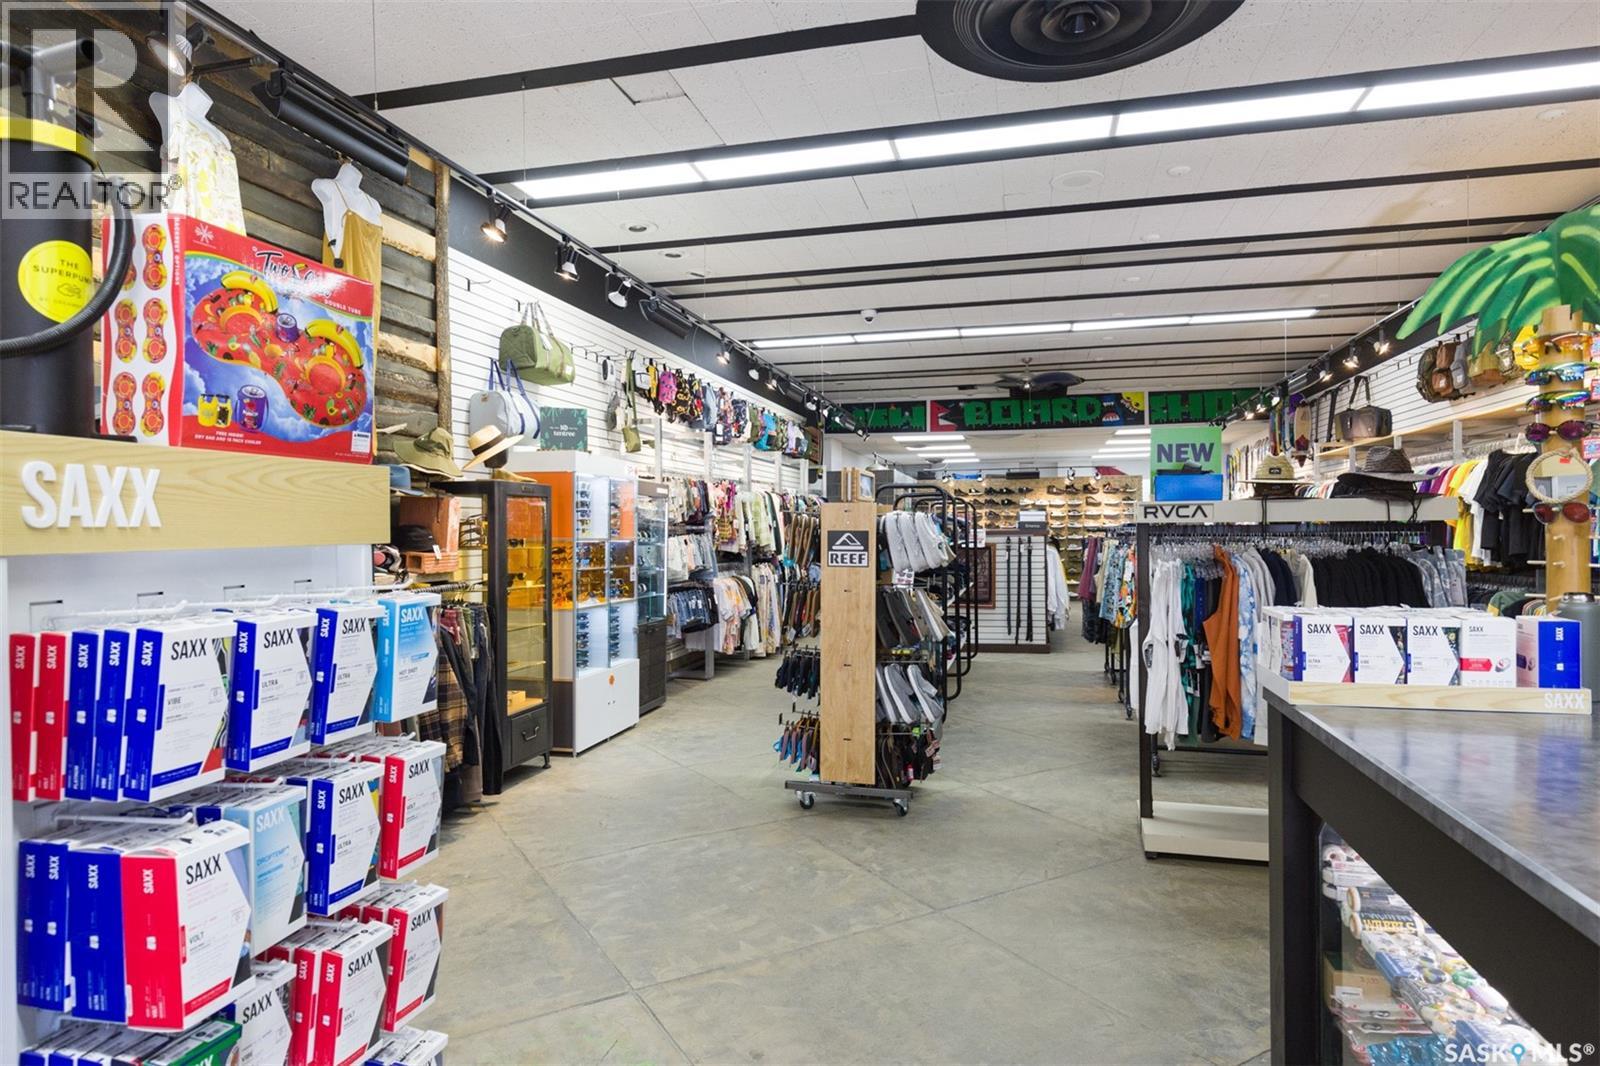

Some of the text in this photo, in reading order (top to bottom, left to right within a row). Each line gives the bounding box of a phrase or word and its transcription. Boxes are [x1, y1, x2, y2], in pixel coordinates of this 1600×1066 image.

[60, 260, 79, 270] THE
[963, 396, 1100, 425] BOARD
[1156, 442, 1215, 463] NEW
[20, 460, 162, 528] SAXX
[1143, 504, 1208, 519] RVCA
[829, 553, 867, 565] REEF
[342, 617, 367, 634] SAXX
[401, 606, 425, 623] SAXX
[263, 627, 294, 649] SAXX
[320, 617, 331, 638] SAXX
[1307, 623, 1332, 635] SAXX
[1359, 624, 1385, 636] SAXX
[1412, 625, 1439, 637] SAXX
[1555, 627, 1564, 641] SAXX
[109, 641, 121, 666] SAXX
[141, 641, 154, 666] SAXX
[171, 638, 207, 660] SAXX
[238, 631, 249, 654] SAXX
[14, 645, 26, 669] SAXX
[46, 645, 57, 669] SAXX
[77, 643, 89, 668] SAXX
[261, 680, 279, 689] ULTRA
[1543, 692, 1586, 710] SAXX
[390, 765, 398, 784] SAXX
[408, 758, 430, 779] SAXX
[317, 790, 327, 810] SAXX
[338, 781, 366, 805] SAXX
[255, 803, 286, 833] SAXX
[25, 854, 35, 879] SAXX
[48, 856, 60, 880] SAXX
[88, 864, 99, 890] SAXX
[186, 854, 222, 885] SAXX
[143, 869, 154, 895] SAXX
[411, 908, 433, 931] SAXX
[299, 960, 308, 980] SAXX
[326, 963, 336, 984] SAXX
[348, 949, 374, 978] SAXX
[242, 991, 273, 1025] SAXX
